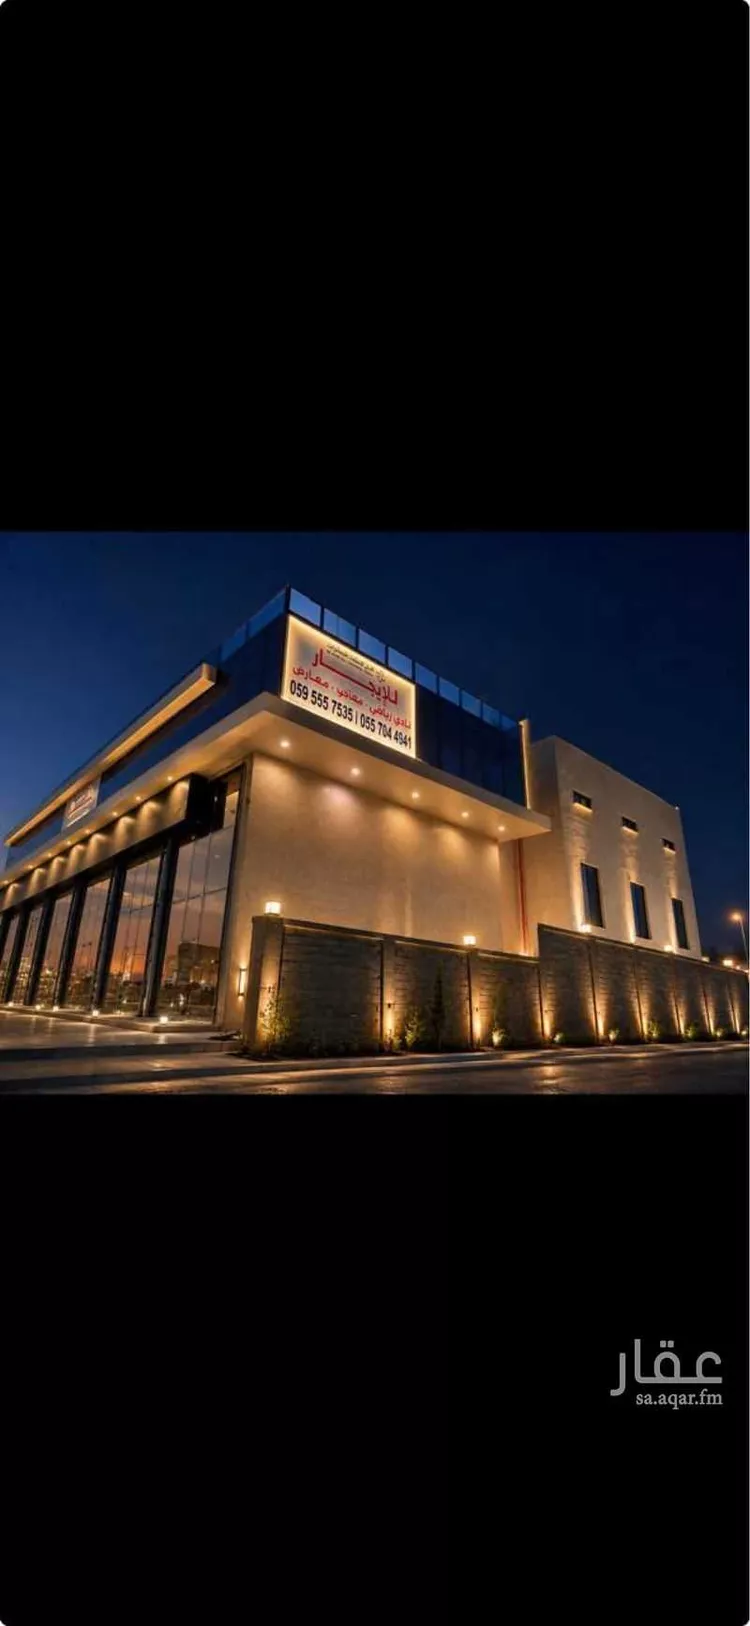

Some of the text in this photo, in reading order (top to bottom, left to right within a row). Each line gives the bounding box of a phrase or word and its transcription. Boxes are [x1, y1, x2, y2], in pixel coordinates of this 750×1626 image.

[293, 665, 329, 689] معارض
[312, 648, 399, 707] للإيجار
[290, 680, 308, 701] 059
[310, 690, 329, 711] 555
[332, 700, 353, 722] 7535
[360, 714, 376, 732] 055
